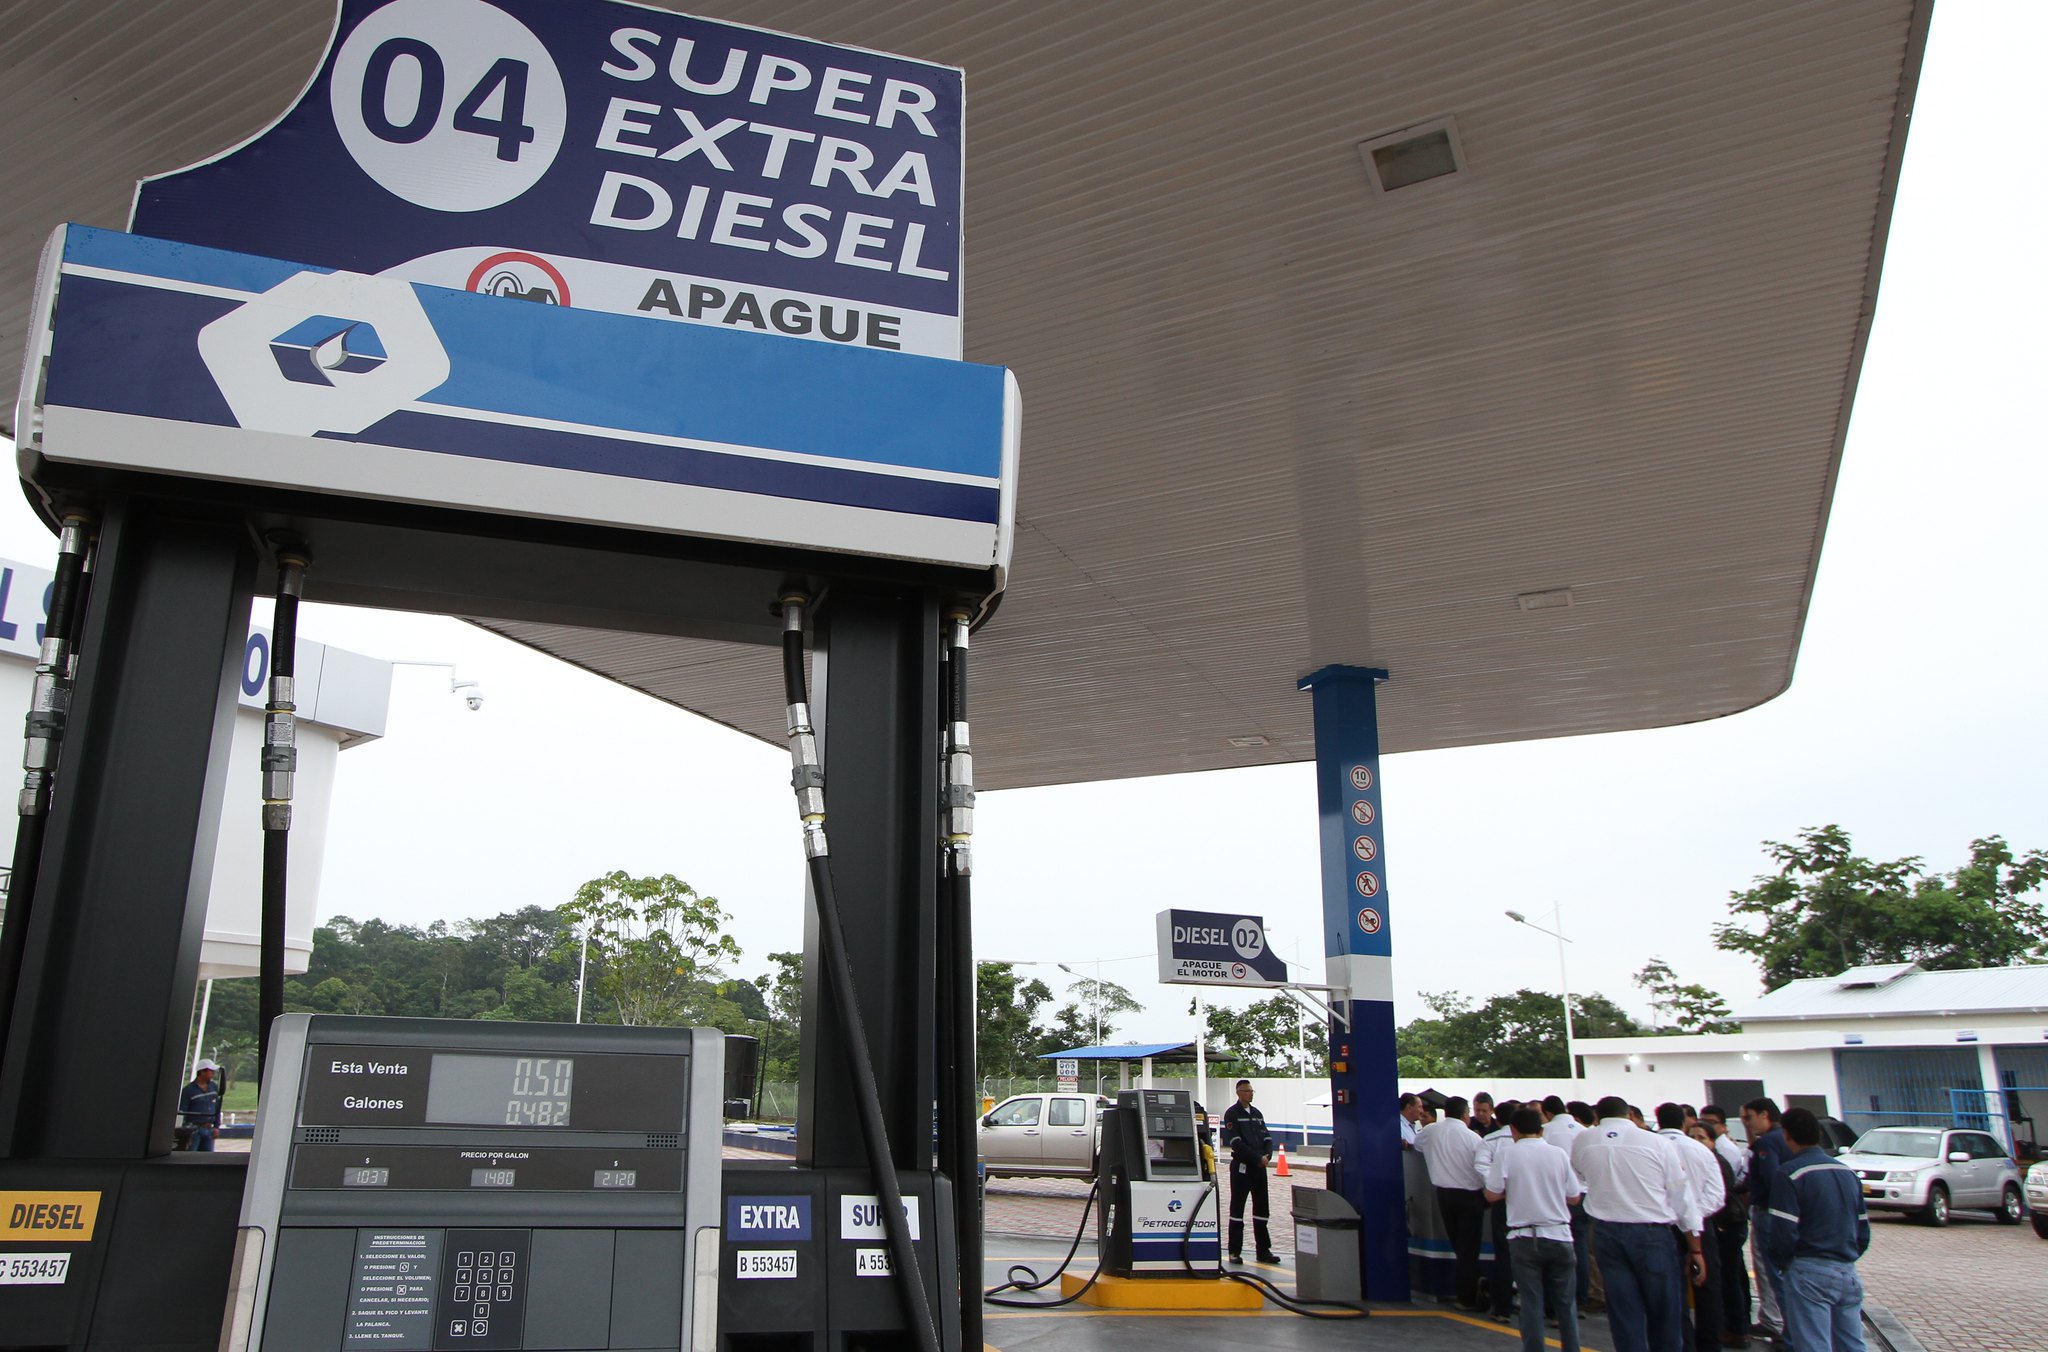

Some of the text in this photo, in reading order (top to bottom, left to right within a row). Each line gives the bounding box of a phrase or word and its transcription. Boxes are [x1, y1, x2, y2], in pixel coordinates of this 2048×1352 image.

[601, 26, 937, 138] SUPER
[360, 37, 535, 163] 04
[595, 96, 937, 208] EXTRA
[589, 169, 950, 282] DIESEL
[637, 278, 902, 351] APAGUE
[1355, 770, 1366, 780] 10
[1174, 926, 1259, 949] DIESEL 02
[1182, 961, 1222, 969] APAGUE
[1193, 970, 1227, 978] MOTOR
[331, 1061, 408, 1075] Esta Venta
[513, 1058, 572, 1096] 0.50
[344, 1096, 404, 1109] Galones
[505, 1100, 568, 1126] 0.482
[356, 1171, 388, 1184] 1.037
[484, 1172, 513, 1185] 1.480
[602, 1172, 635, 1186] 2.120
[10, 1204, 84, 1229] DIESEL
[740, 1206, 800, 1229] EXTRA
[10, 1259, 67, 1277] 553457
[740, 1256, 795, 1272] B 553457
[859, 1255, 866, 1269] A
